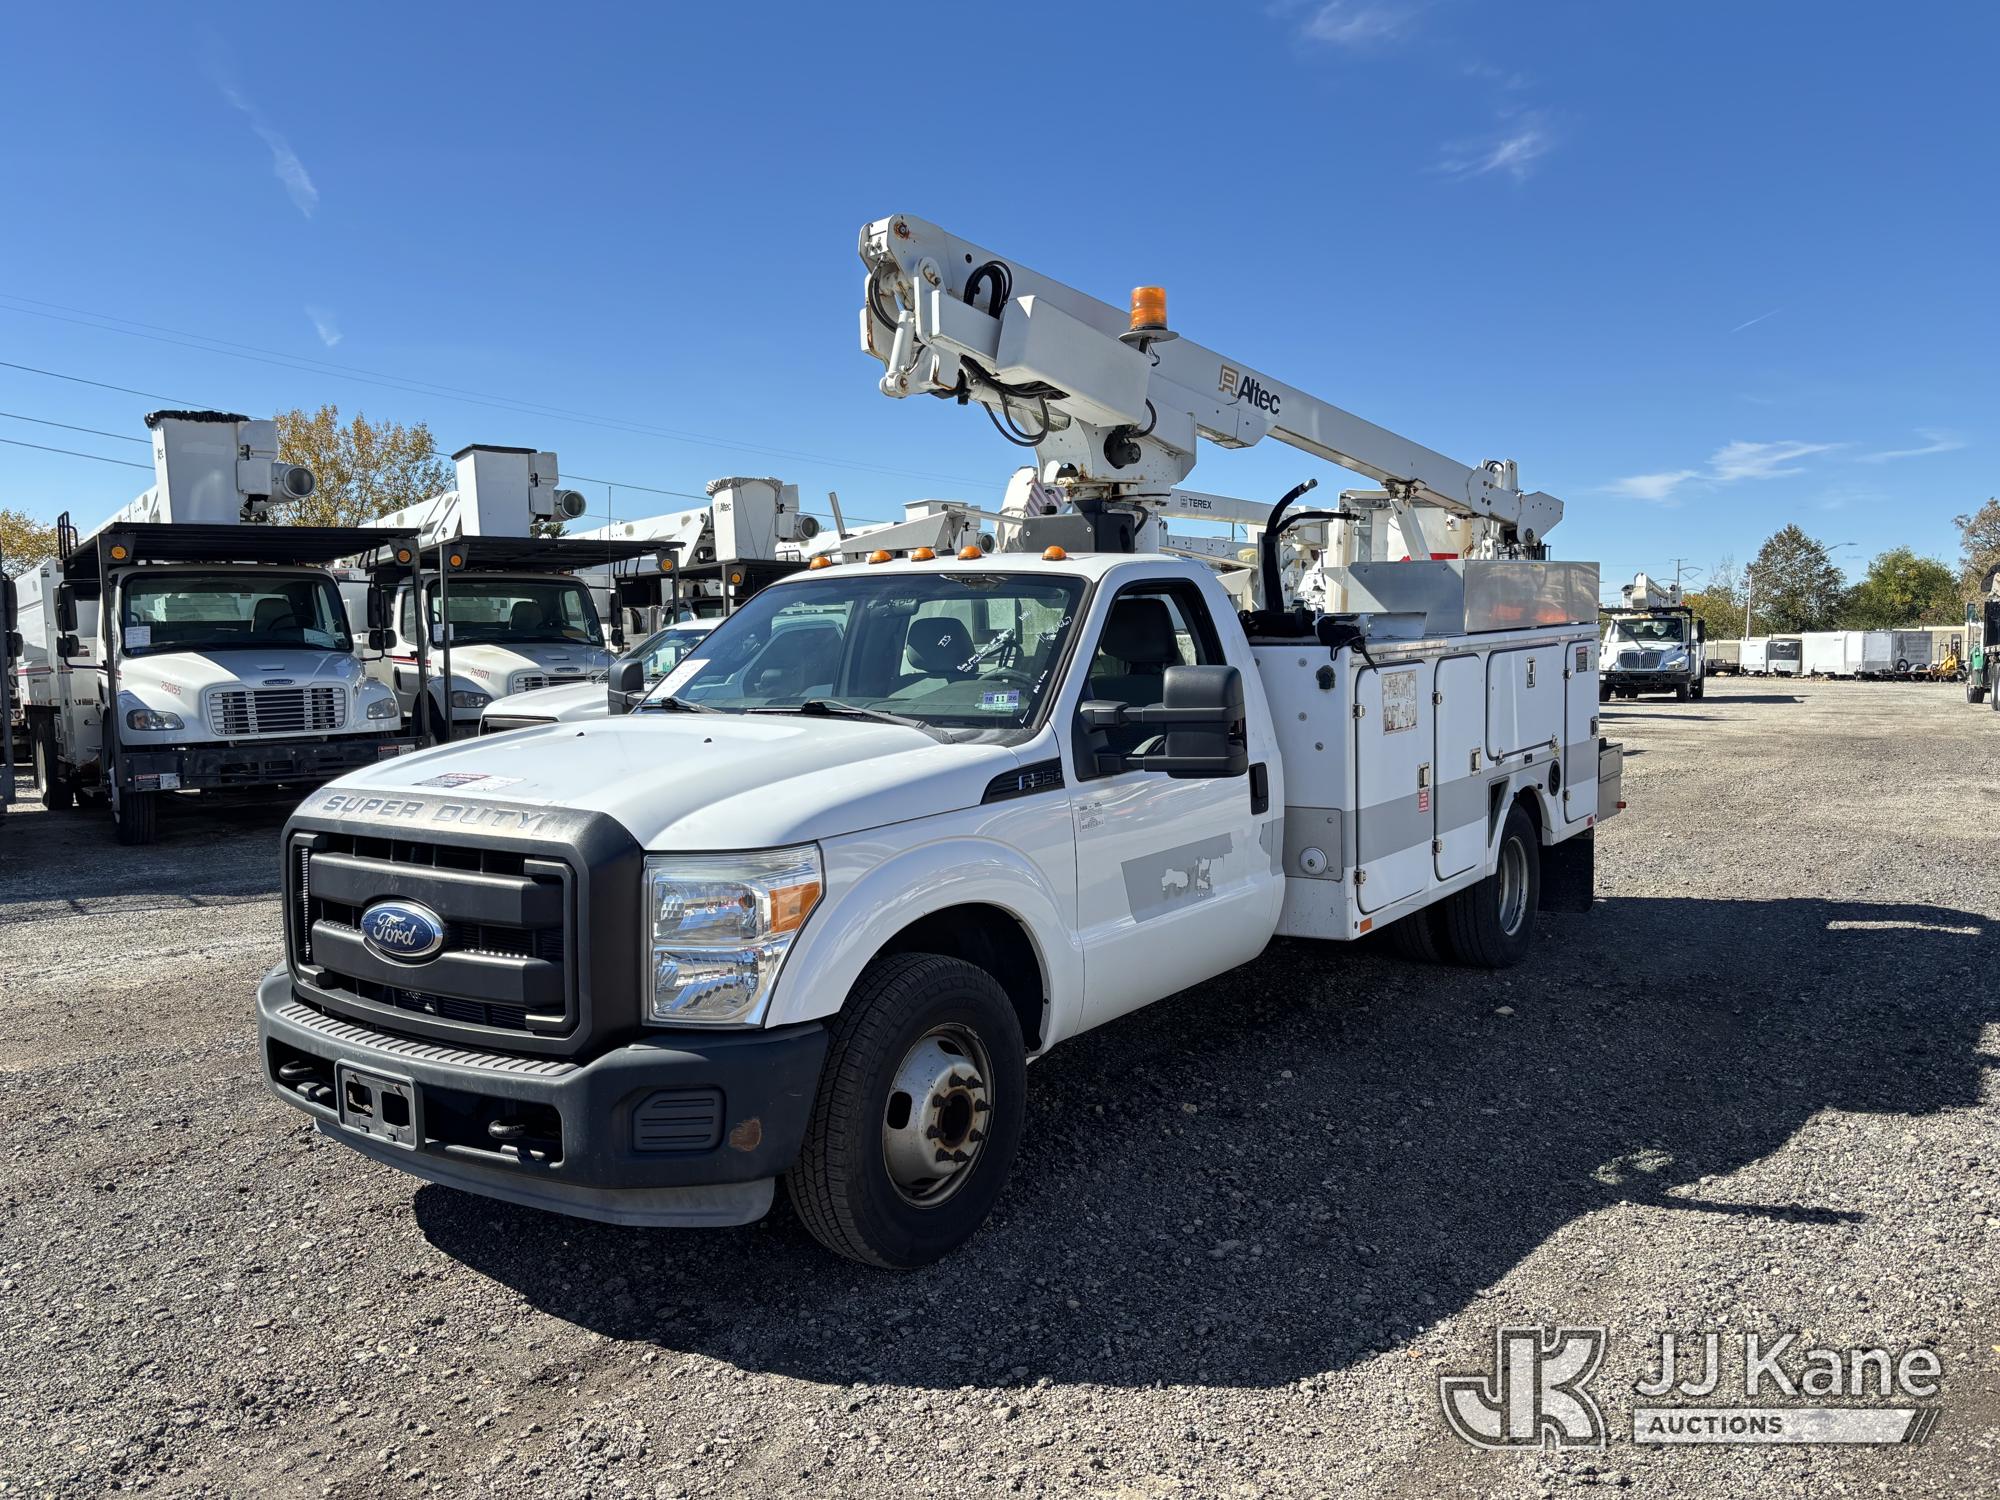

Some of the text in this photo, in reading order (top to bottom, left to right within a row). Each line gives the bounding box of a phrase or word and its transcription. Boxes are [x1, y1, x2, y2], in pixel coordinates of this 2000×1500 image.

[1236, 375, 1281, 415] Altec
[1188, 497, 1212, 510] TEREX
[322, 794, 548, 829] SUPER DUTY
[373, 912, 417, 946] Ford
